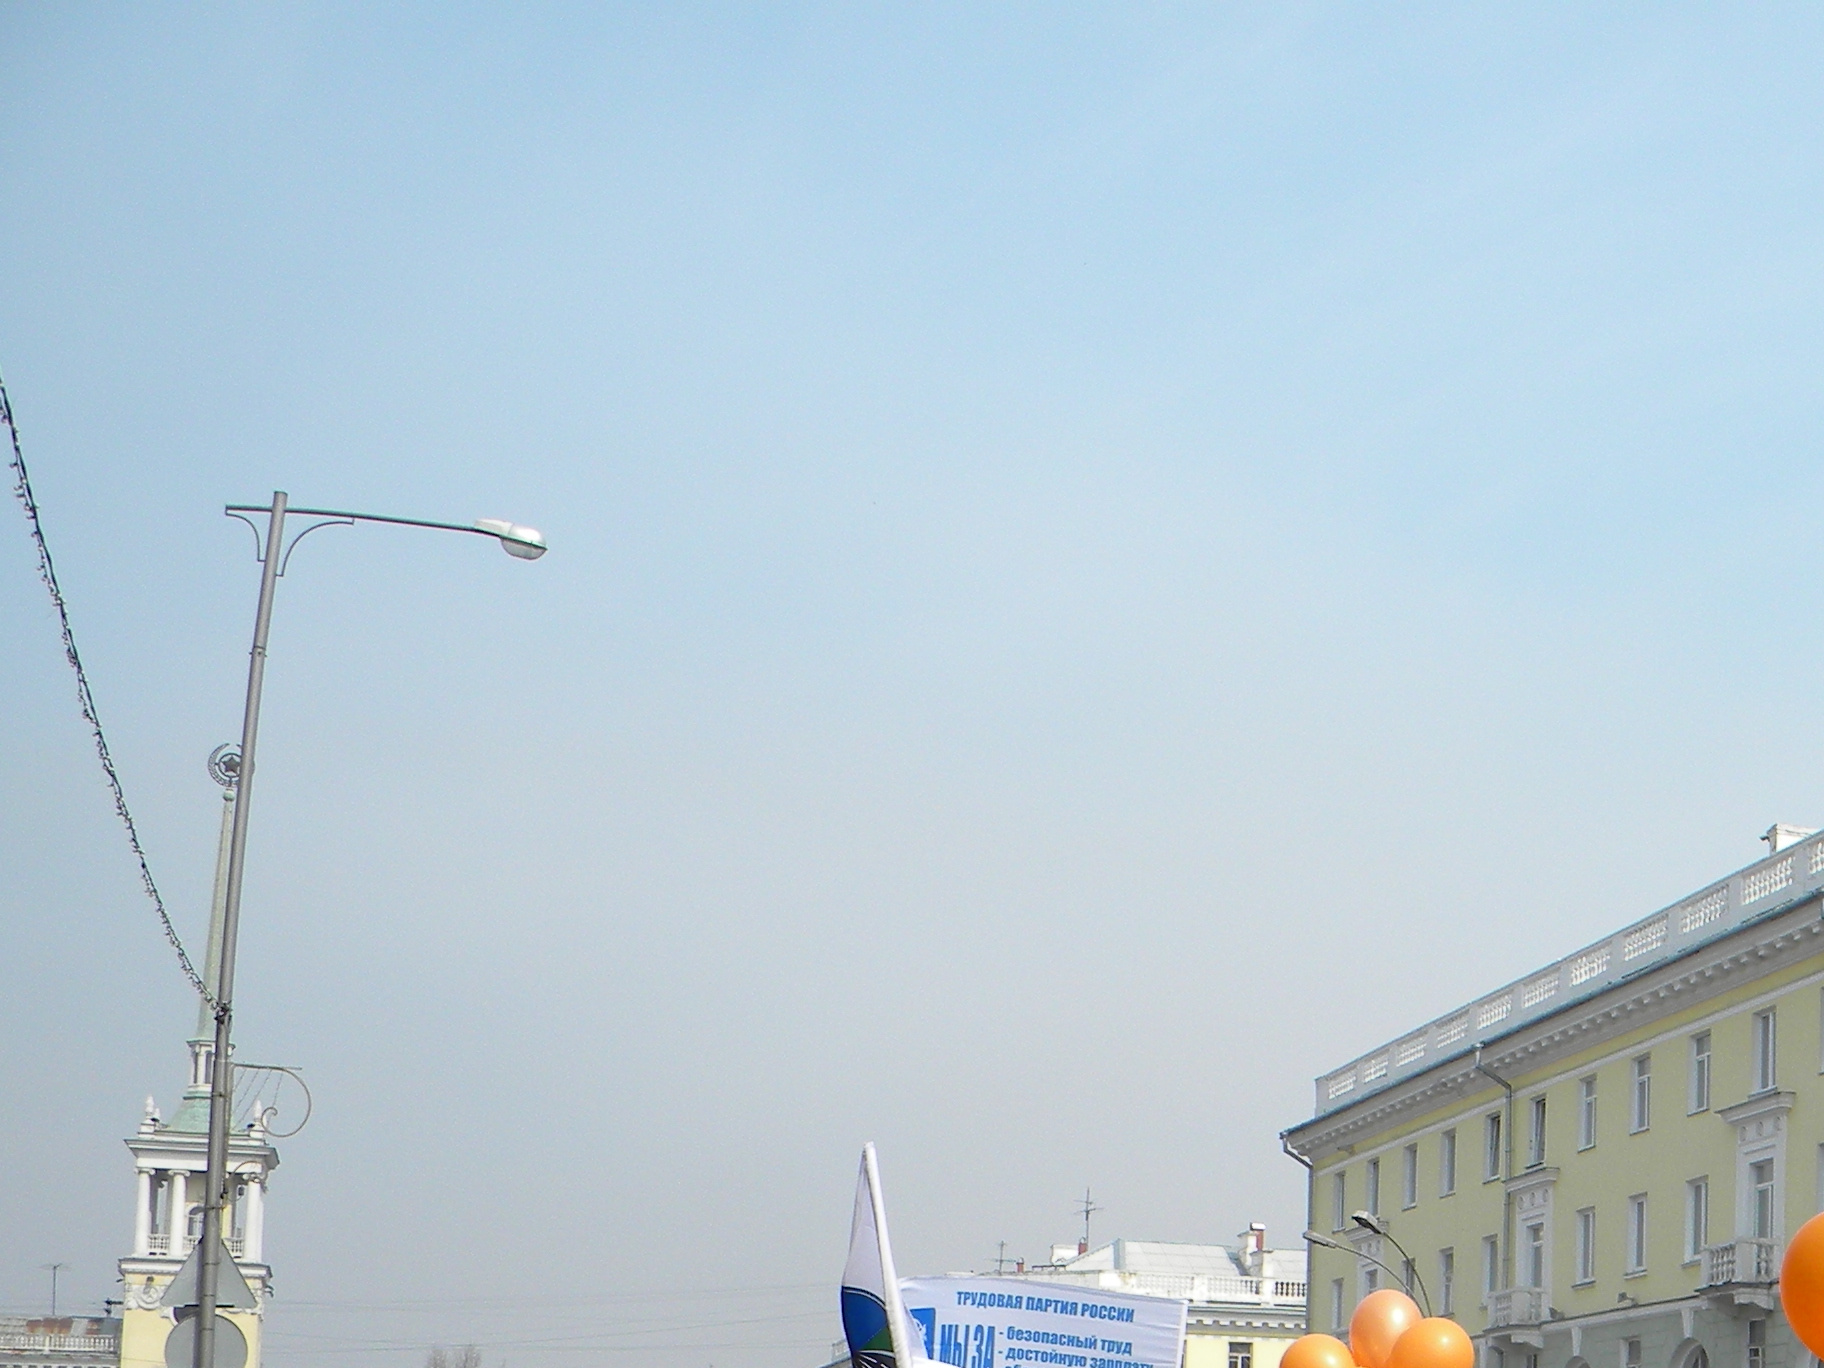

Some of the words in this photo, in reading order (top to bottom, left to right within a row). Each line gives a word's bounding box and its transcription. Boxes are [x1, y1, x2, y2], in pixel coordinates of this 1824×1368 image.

[956, 1291, 1023, 1310] ТРУДОВАЯ
[1026, 1295, 1078, 1317] ПАРТИЯ
[1080, 1303, 1135, 1323] РОССИИ
[1005, 1346, 1087, 1368] достойную
[1006, 1326, 1097, 1350] безопасный
[1100, 1339, 1133, 1357] труд
